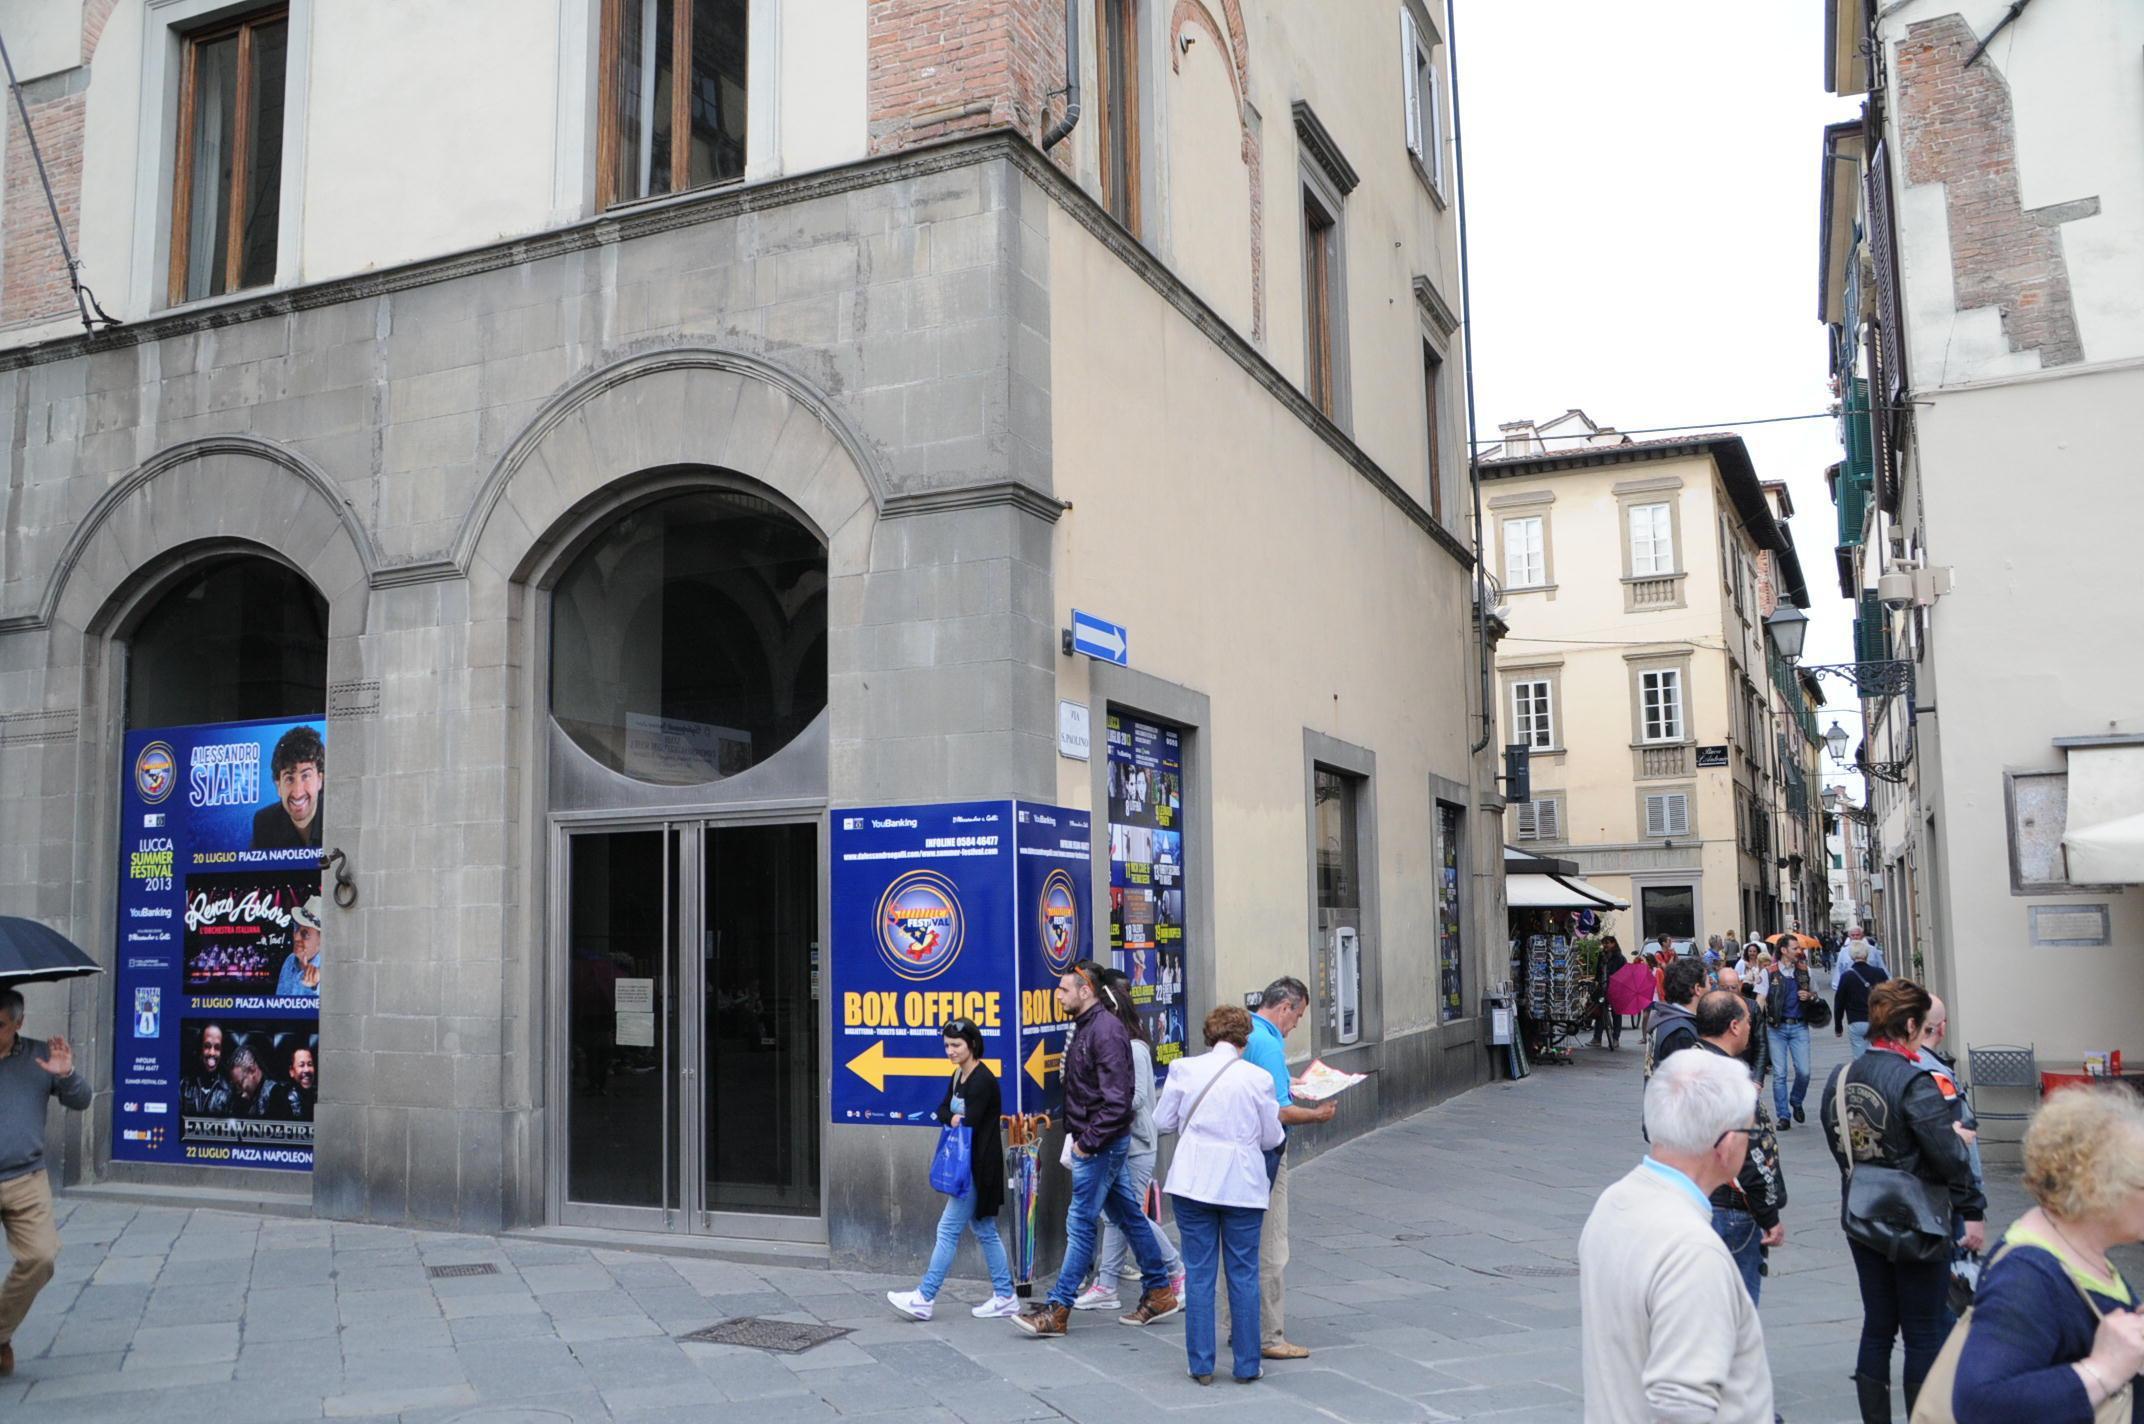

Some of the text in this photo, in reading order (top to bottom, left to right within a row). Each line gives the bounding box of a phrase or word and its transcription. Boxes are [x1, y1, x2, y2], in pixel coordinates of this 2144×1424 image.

[1071, 710, 1080, 721] VIA
[191, 743, 260, 766] ALESSANDRO
[189, 761, 260, 807] SIANI
[871, 818, 918, 829] YouBanking
[140, 838, 173, 852] LUCCA
[925, 835, 999, 848] INFOLINE 0584 46477
[131, 852, 173, 866] SUMMER
[193, 853, 204, 863] 20
[206, 852, 237, 863] LUGLIO
[238, 850, 267, 862] PIAZZA
[130, 865, 173, 879] FESTIVAL
[145, 878, 172, 892] 2013
[129, 907, 172, 919] YouBanking
[185, 891, 292, 931] Renzo Arbore
[199, 925, 261, 935] L'ORCHESTRA ITALIANA
[908, 918, 951, 928] FESTIVAL
[191, 998, 320, 1009] 21 LUGLIO PIAZZA NAPOLEONE
[844, 991, 1001, 1027] BOX OFFICE
[1022, 989, 1052, 1025] BOX
[184, 1119, 231, 1137] EARTH
[229, 1120, 275, 1141] WIND
[186, 1147, 313, 1163] 22 LUGLIO PIAZZA NAPOLEON
